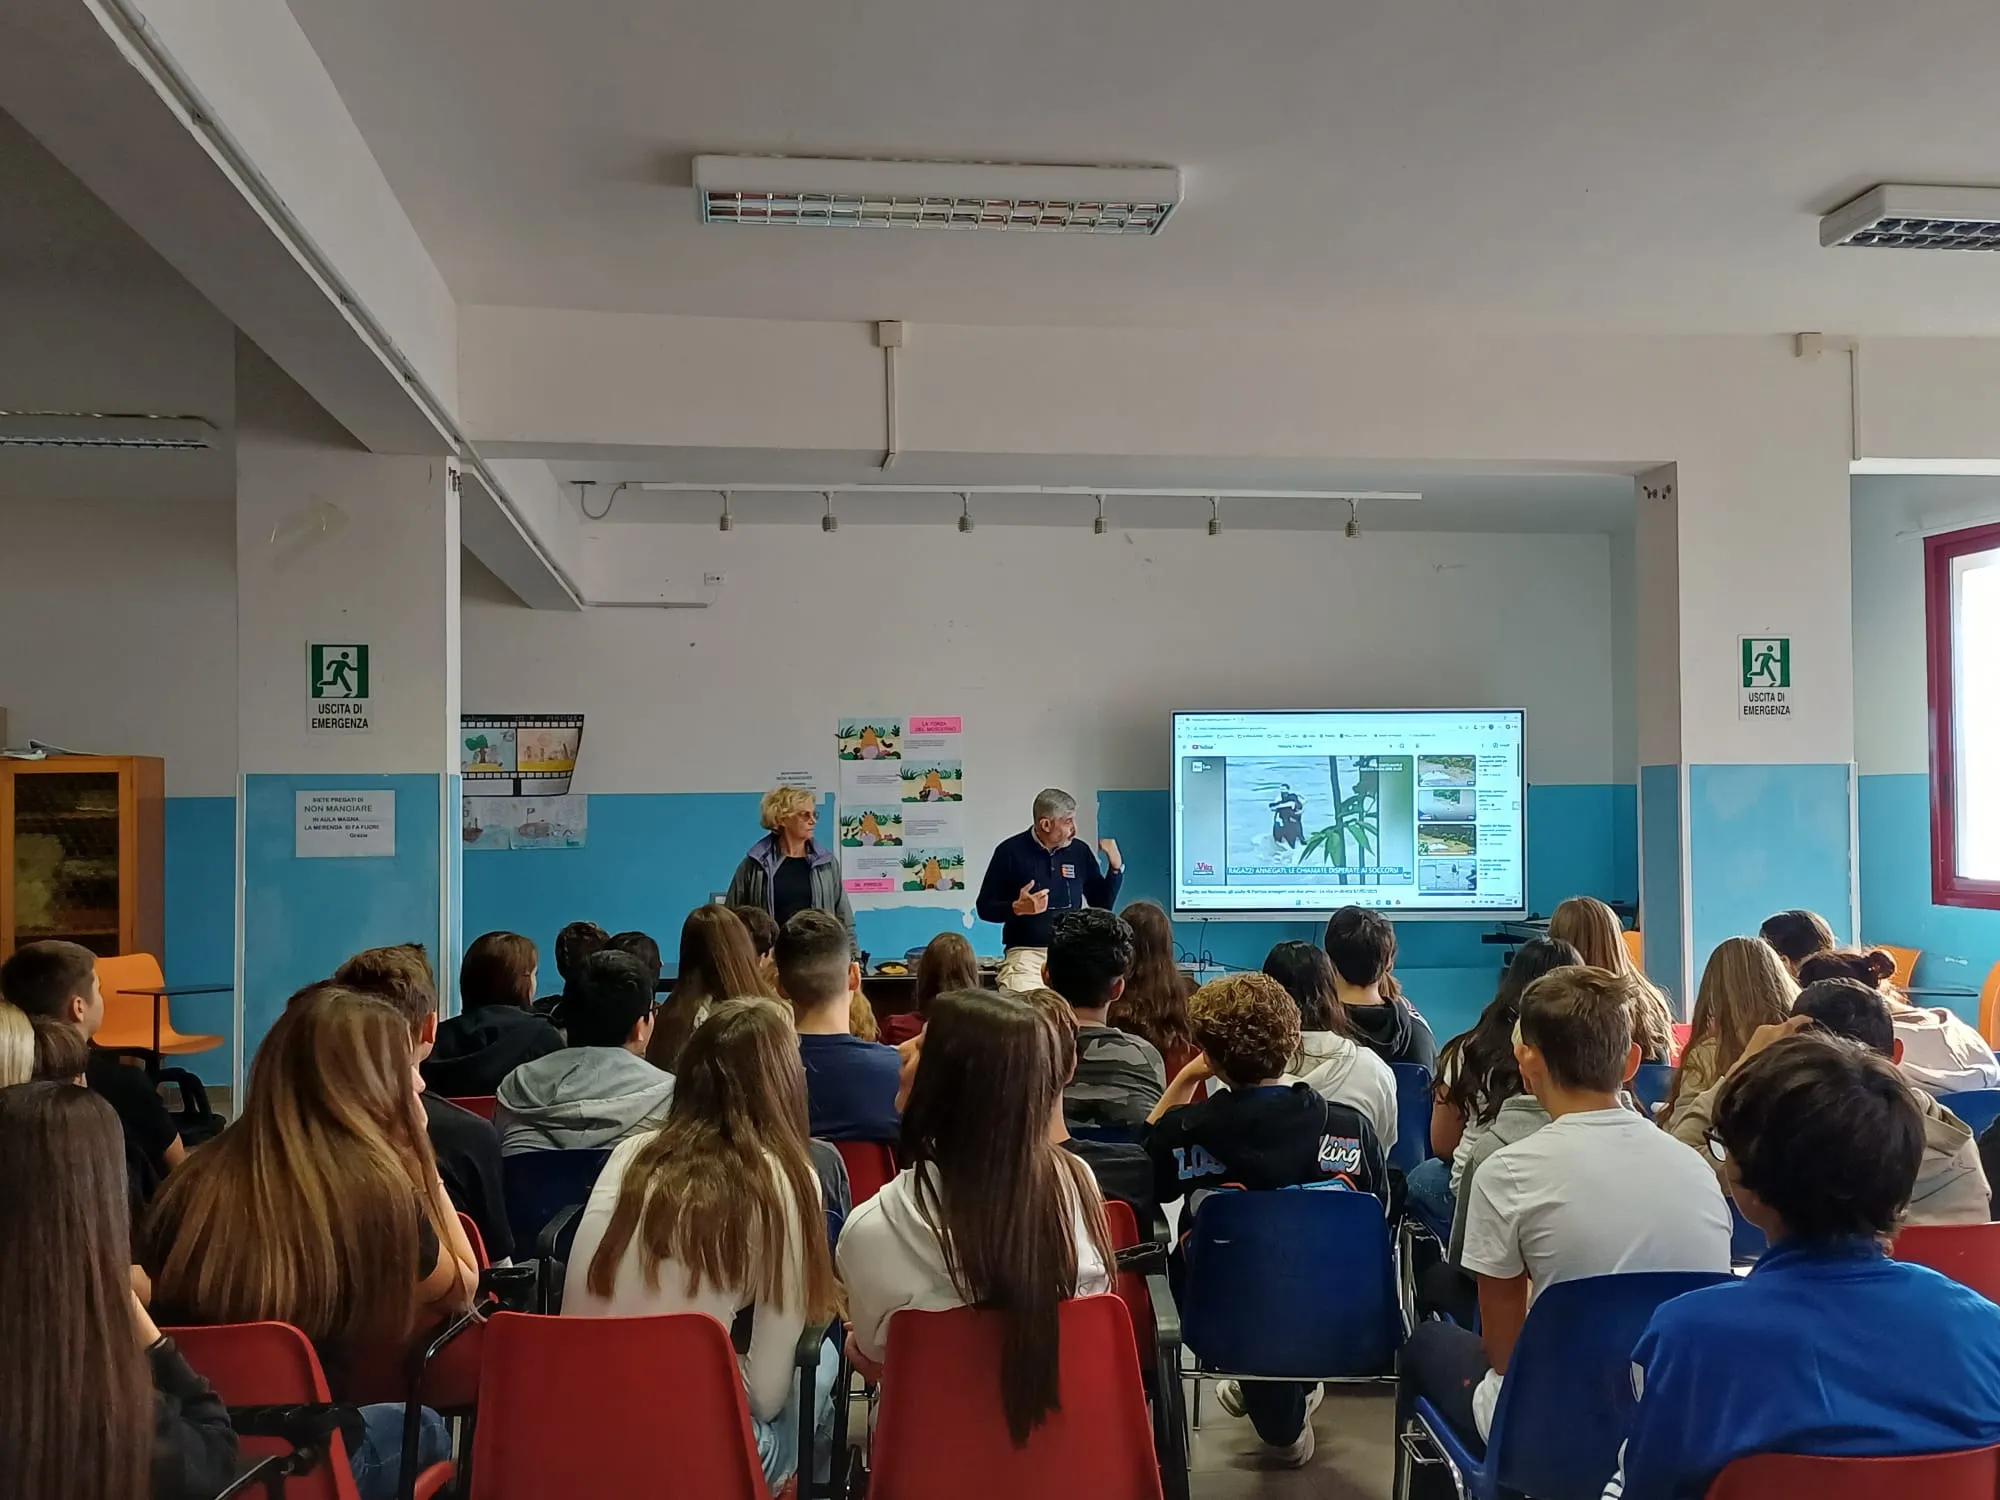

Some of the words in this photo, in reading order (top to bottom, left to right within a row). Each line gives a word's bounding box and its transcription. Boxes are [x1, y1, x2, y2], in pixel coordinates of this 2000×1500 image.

[1748, 692, 1776, 702] USCITA
[1777, 692, 1785, 702] DI
[318, 703, 351, 714] USCITA
[353, 703, 363, 714] DI
[1743, 705, 1791, 715] EMERGENZA
[311, 717, 369, 729] EMERGENZA
[1317, 1133, 1361, 1173] king
